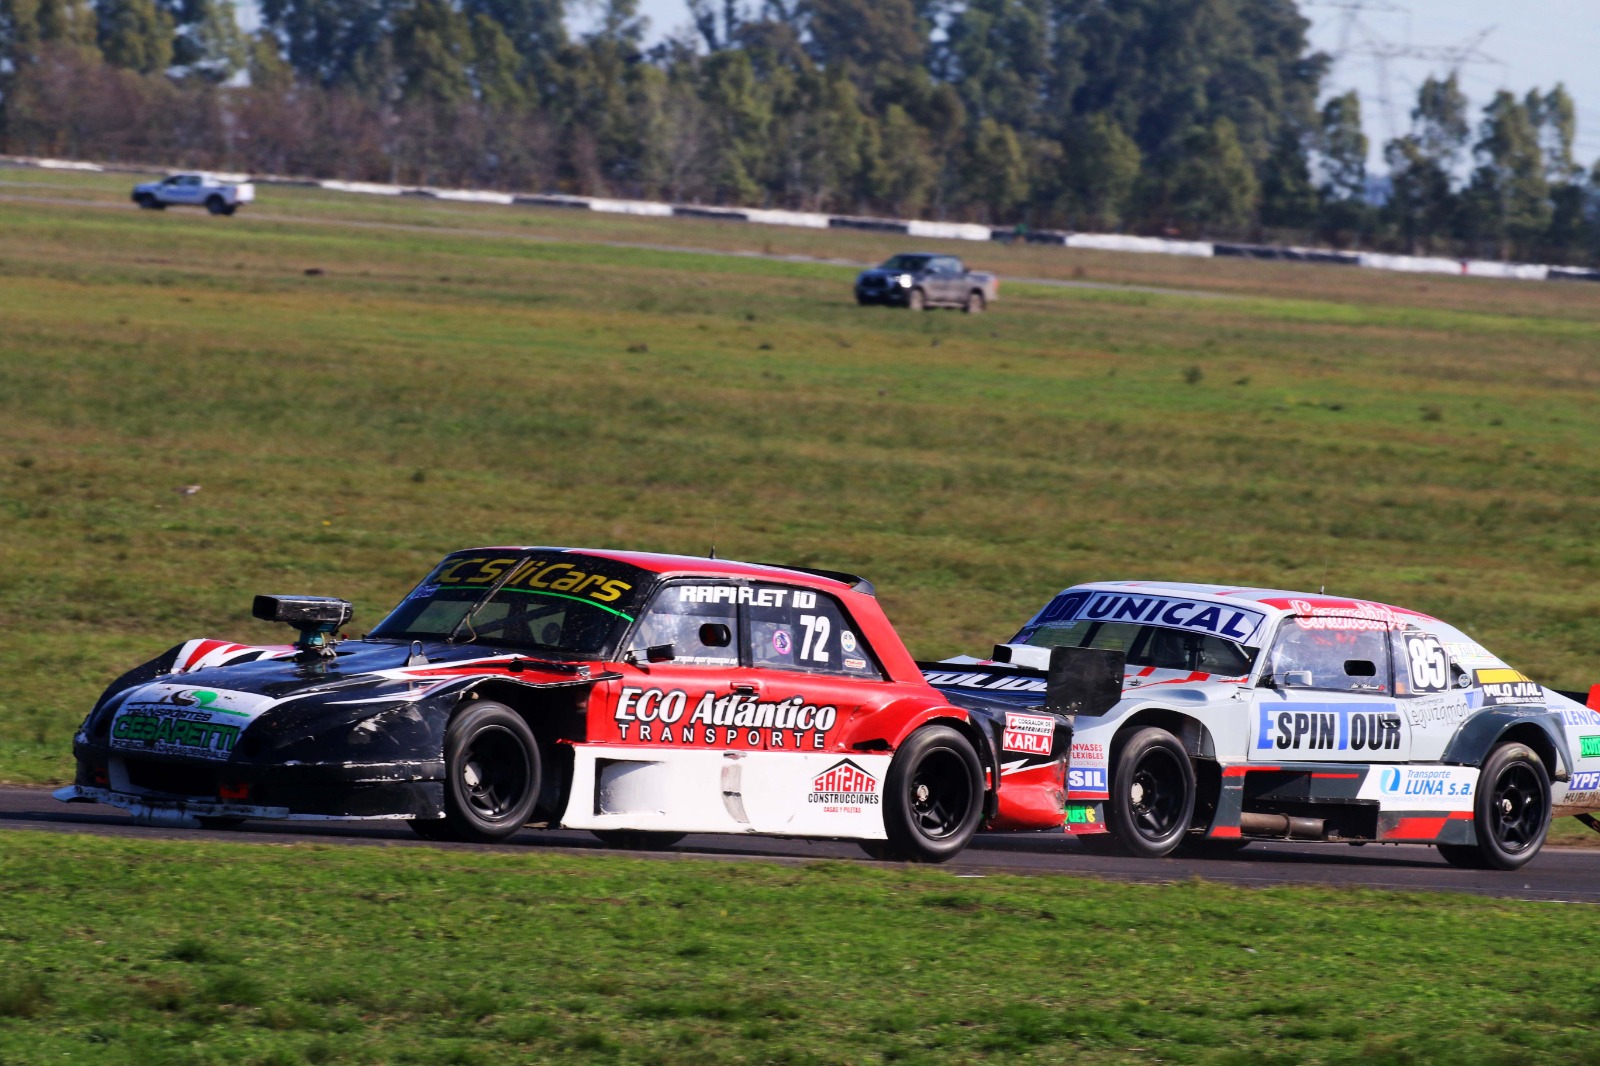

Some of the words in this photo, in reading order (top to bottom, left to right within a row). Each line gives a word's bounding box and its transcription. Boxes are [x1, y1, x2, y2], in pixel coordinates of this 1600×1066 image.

[1087, 595, 1247, 639] UNICAL
[799, 614, 831, 663] 72
[1408, 638, 1446, 689] 85
[1483, 683, 1512, 697] MILO
[1514, 682, 1542, 697] VIAL
[127, 708, 213, 722] TRANSPORTES
[615, 687, 687, 723] ECO
[690, 692, 837, 731] Atlántico
[113, 715, 241, 751] CESARETTI
[619, 724, 826, 748] TRANSPORTE
[1017, 725, 1051, 733] MATERIALES
[1005, 732, 1050, 752] KARLA
[1070, 743, 1103, 753] NVASES
[1407, 769, 1451, 780] Transporte
[1572, 772, 1600, 789] YPF
[1405, 780, 1444, 795] LUNA
[1448, 782, 1473, 796] s.a.
[808, 793, 879, 805] CONSTRUCCIONES
